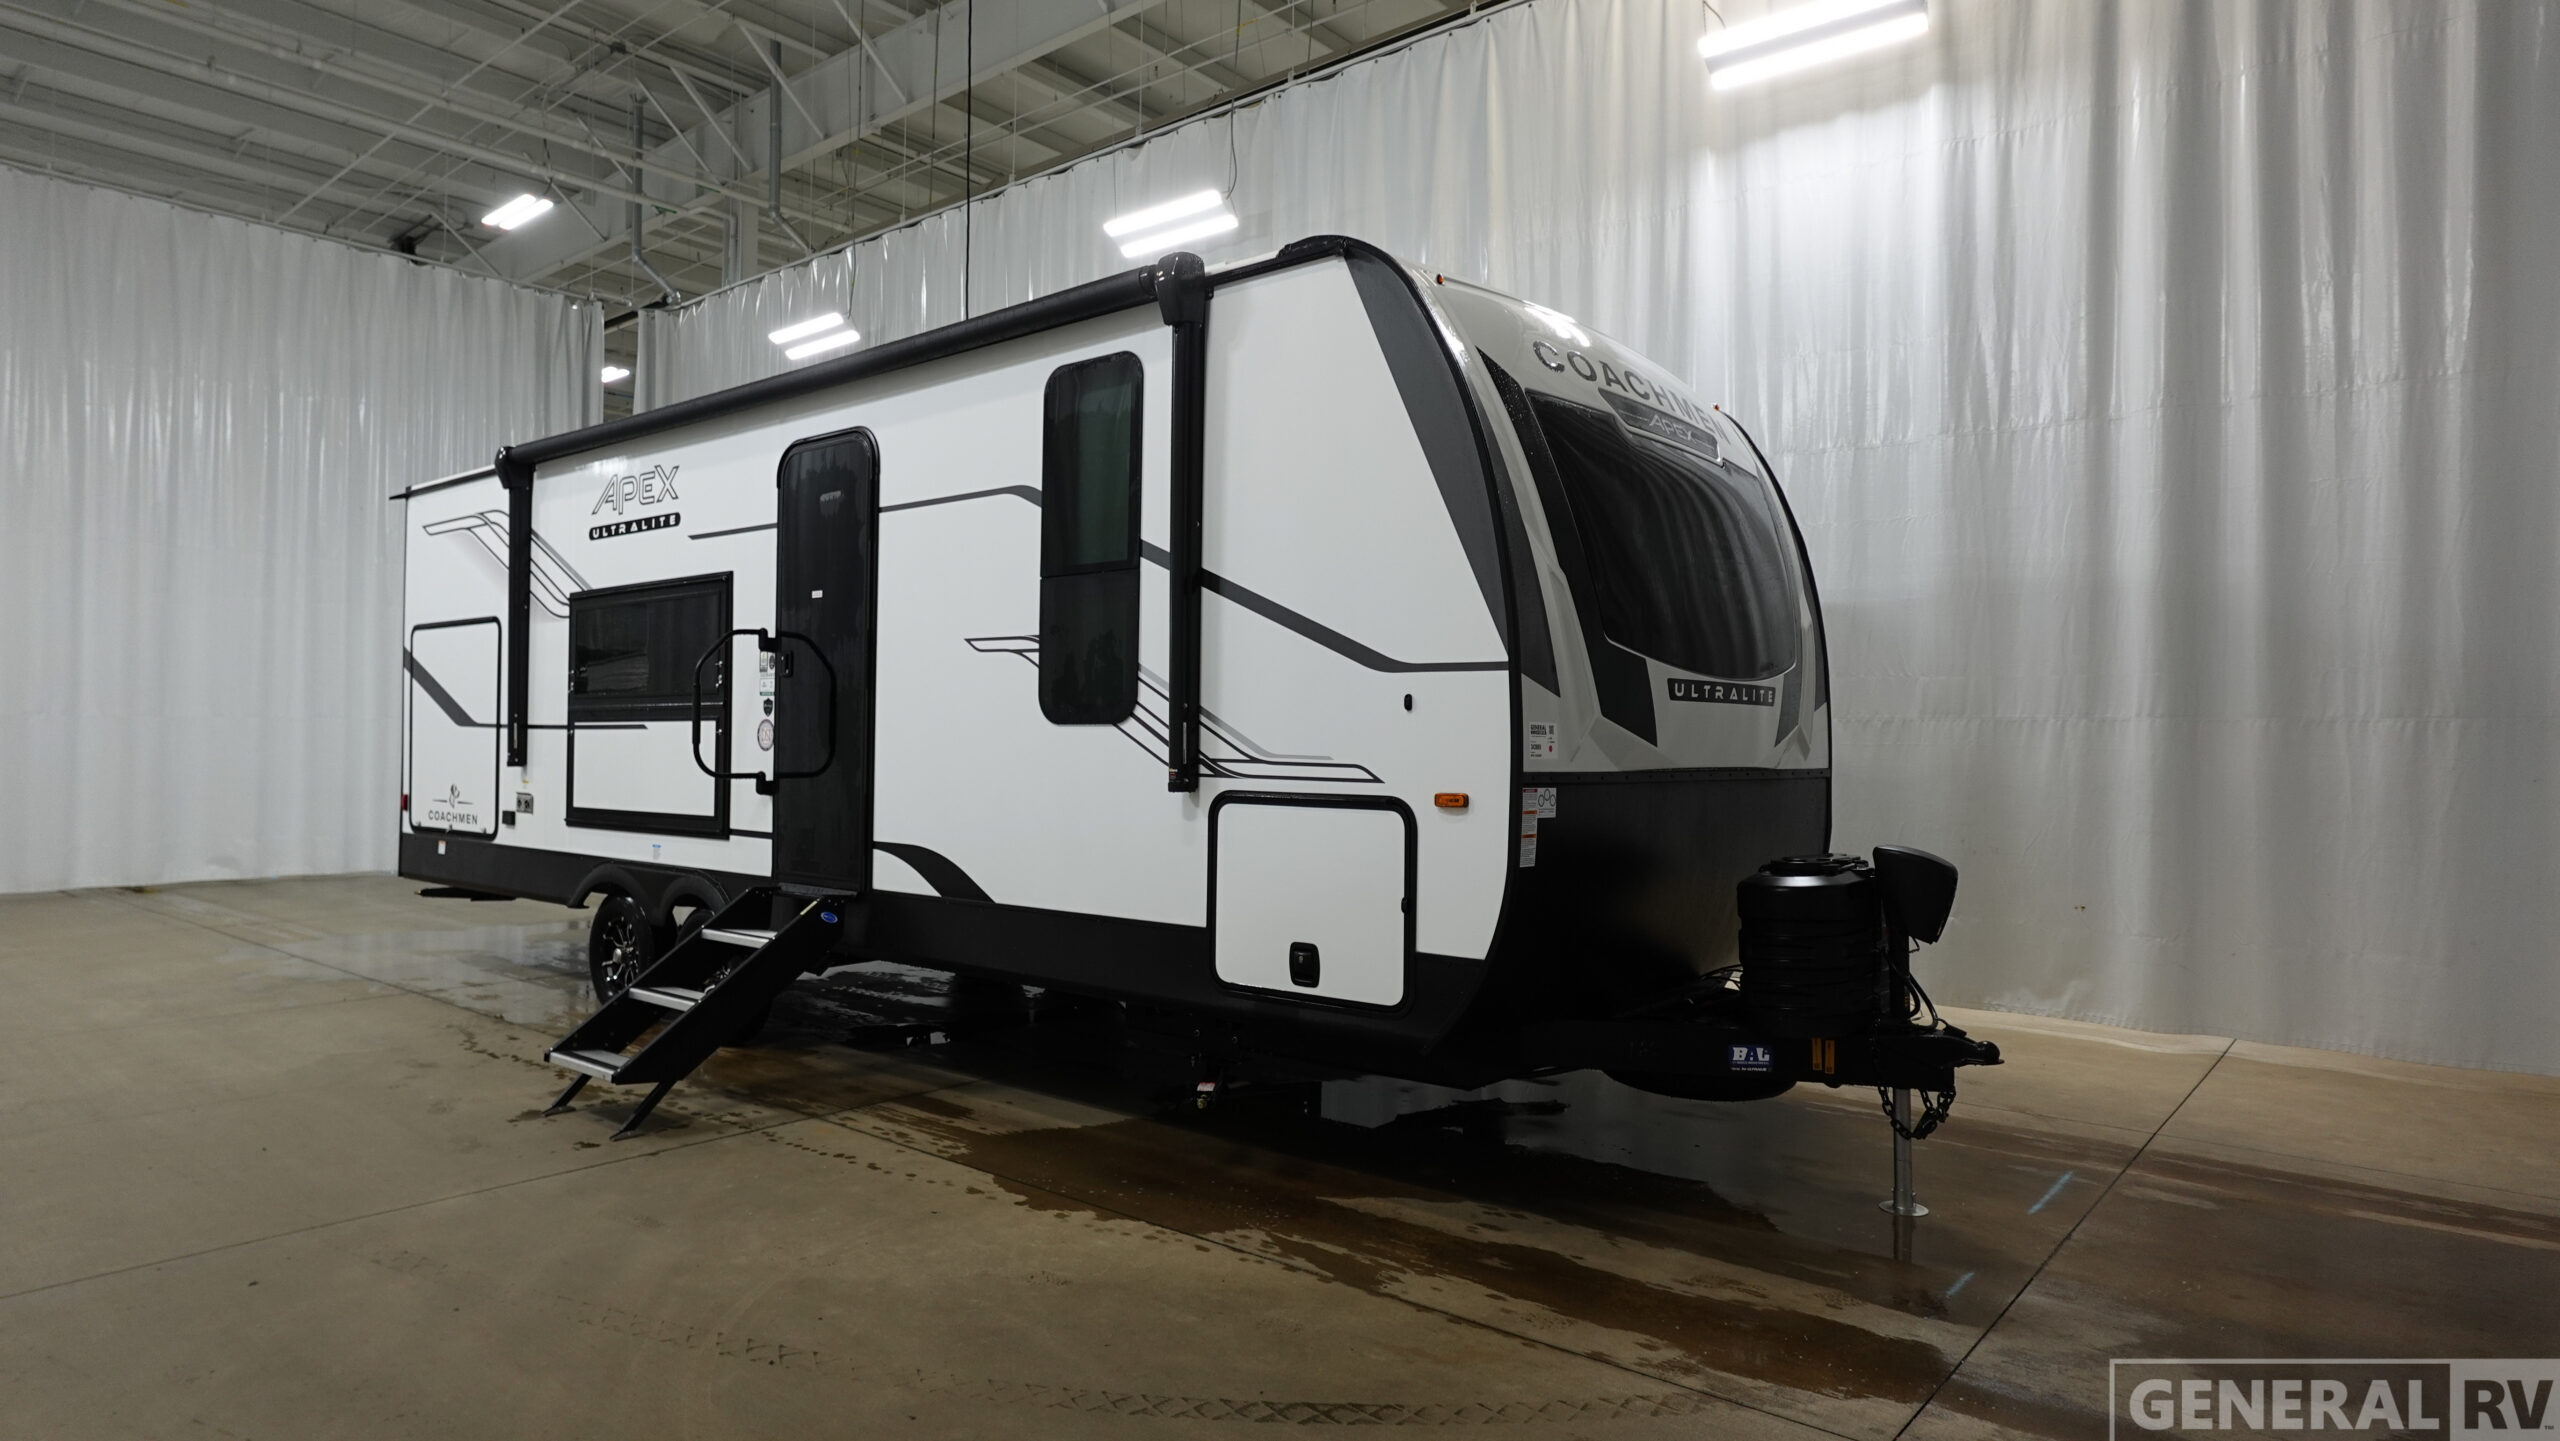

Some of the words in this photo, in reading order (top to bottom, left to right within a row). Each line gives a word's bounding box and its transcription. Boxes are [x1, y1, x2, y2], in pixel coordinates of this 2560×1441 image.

[1532, 340, 1731, 446] COACHMEN
[591, 464, 680, 515] APEX
[592, 514, 677, 539] ULTRALITE
[1674, 682, 1773, 703] ULTRALITE
[428, 809, 479, 825] COACHMEN
